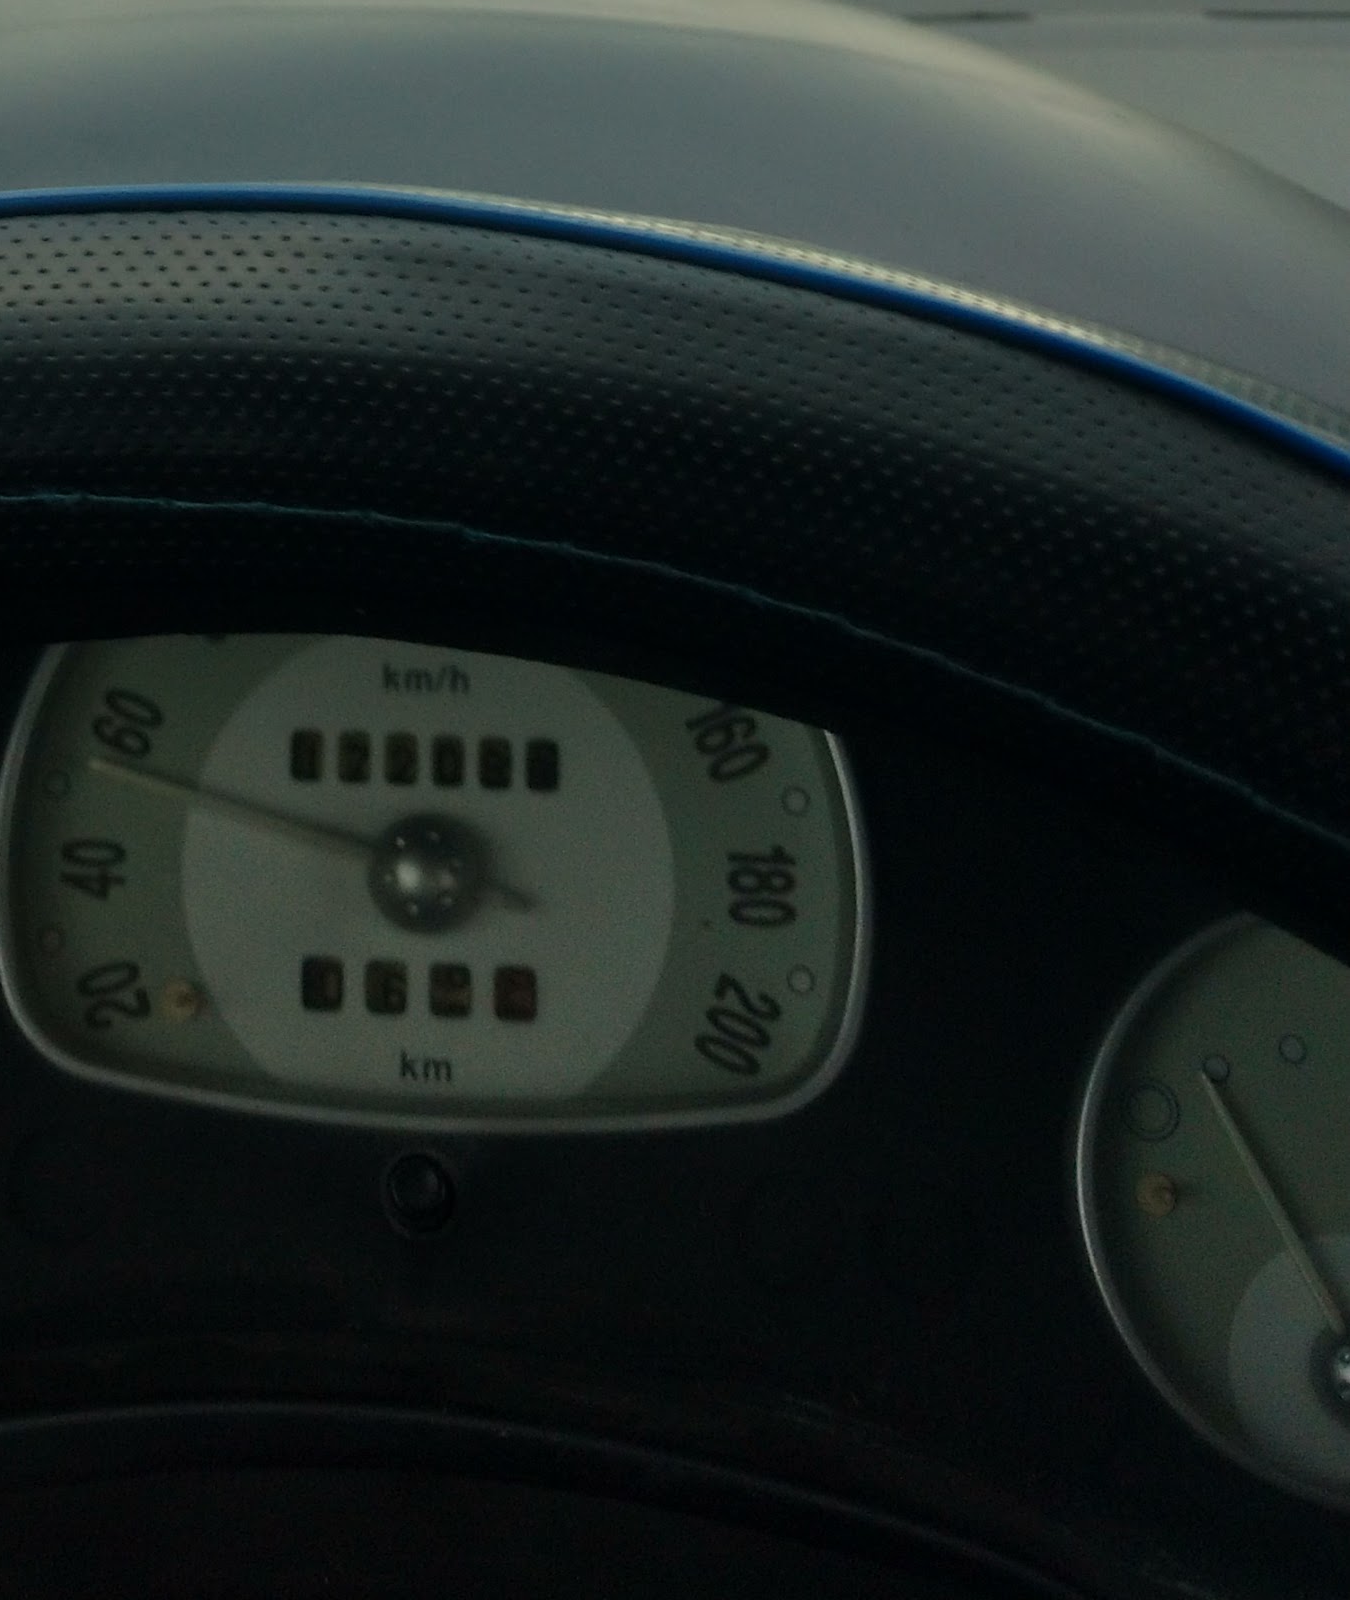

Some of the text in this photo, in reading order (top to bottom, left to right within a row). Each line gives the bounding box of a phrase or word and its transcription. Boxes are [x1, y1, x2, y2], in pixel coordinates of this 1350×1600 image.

[382, 663, 470, 693] km/h
[90, 686, 164, 760] 60
[686, 702, 770, 783] 160
[60, 837, 127, 901] 40
[726, 845, 797, 928] 180
[75, 960, 151, 1030] 20
[694, 973, 782, 1077] 200
[398, 1051, 452, 1084] km
